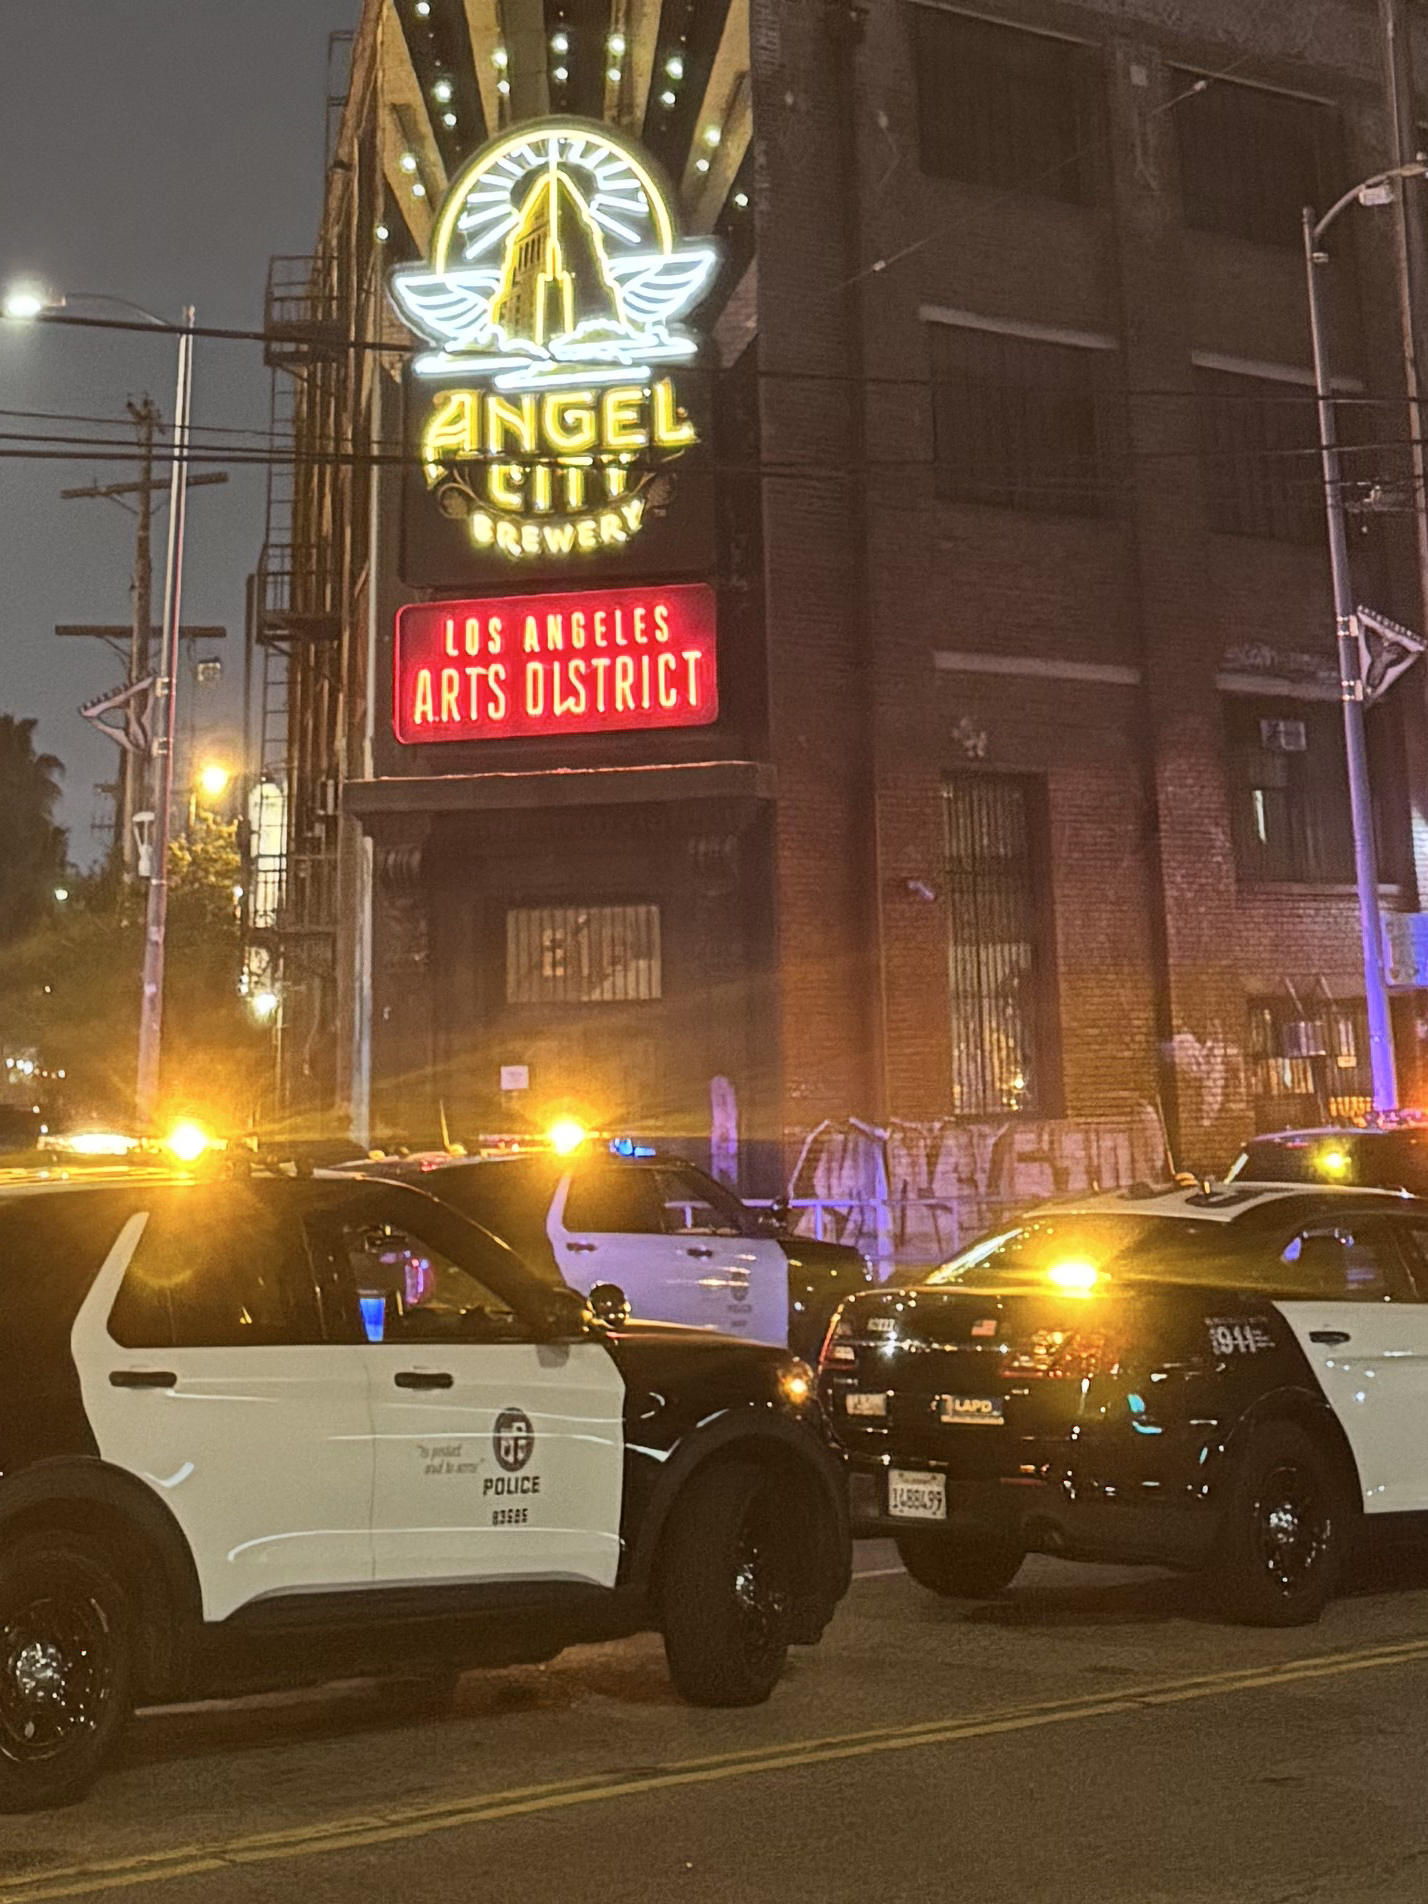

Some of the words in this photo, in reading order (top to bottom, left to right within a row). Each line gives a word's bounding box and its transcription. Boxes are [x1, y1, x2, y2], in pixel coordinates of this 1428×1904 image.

[423, 379, 700, 462] ANGEL
[470, 496, 646, 558] BREWERY
[445, 616, 503, 657] LOS
[523, 604, 670, 653] ANGELES
[413, 663, 507, 725] ARTS
[525, 650, 703, 718] DISTRICT
[954, 1398, 993, 1413] LAPD
[482, 1475, 541, 1497] POLICE
